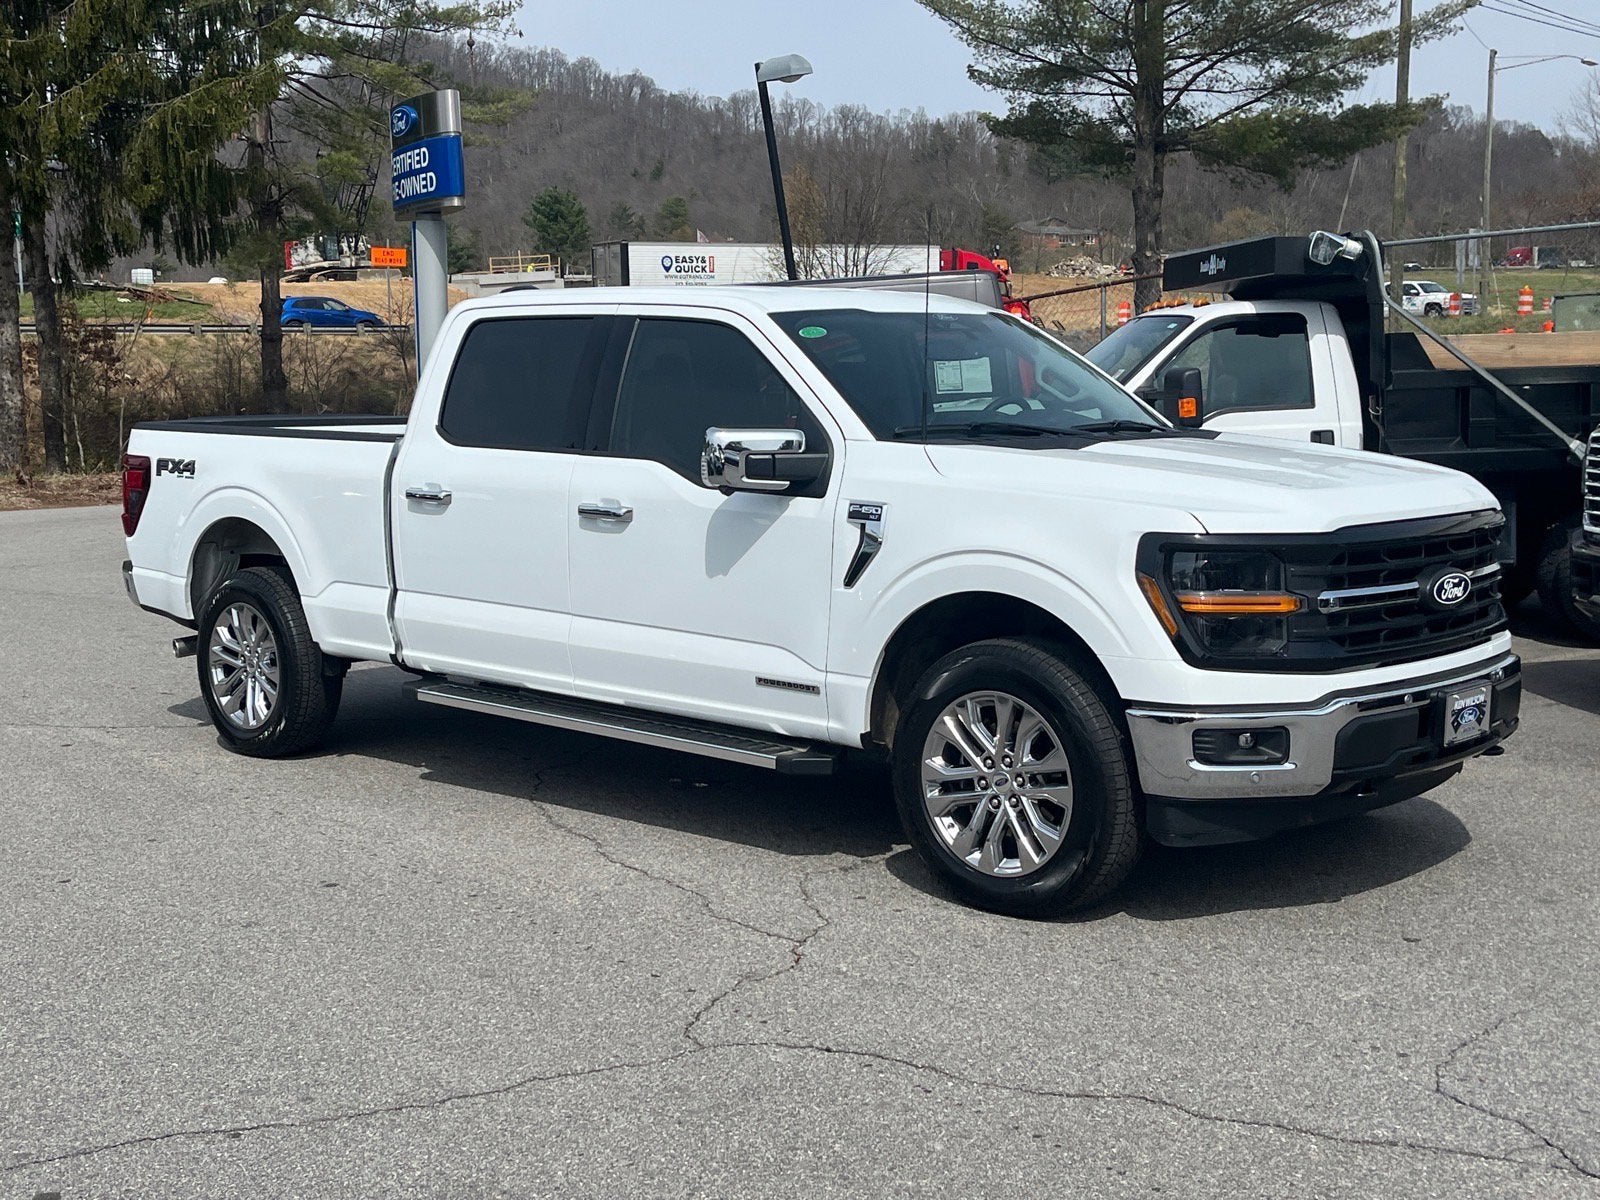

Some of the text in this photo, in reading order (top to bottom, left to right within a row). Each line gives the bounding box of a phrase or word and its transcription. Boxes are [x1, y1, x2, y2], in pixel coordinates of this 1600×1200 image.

[391, 147, 429, 177] ERTIFIED
[392, 171, 436, 200] E-OWNED
[675, 255, 707, 264] EASY&
[675, 265, 707, 273] QUICK
[156, 457, 196, 476] FX4
[850, 505, 882, 515] F-150
[1441, 578, 1465, 600] Ford
[757, 677, 816, 692] POWERBOOST
